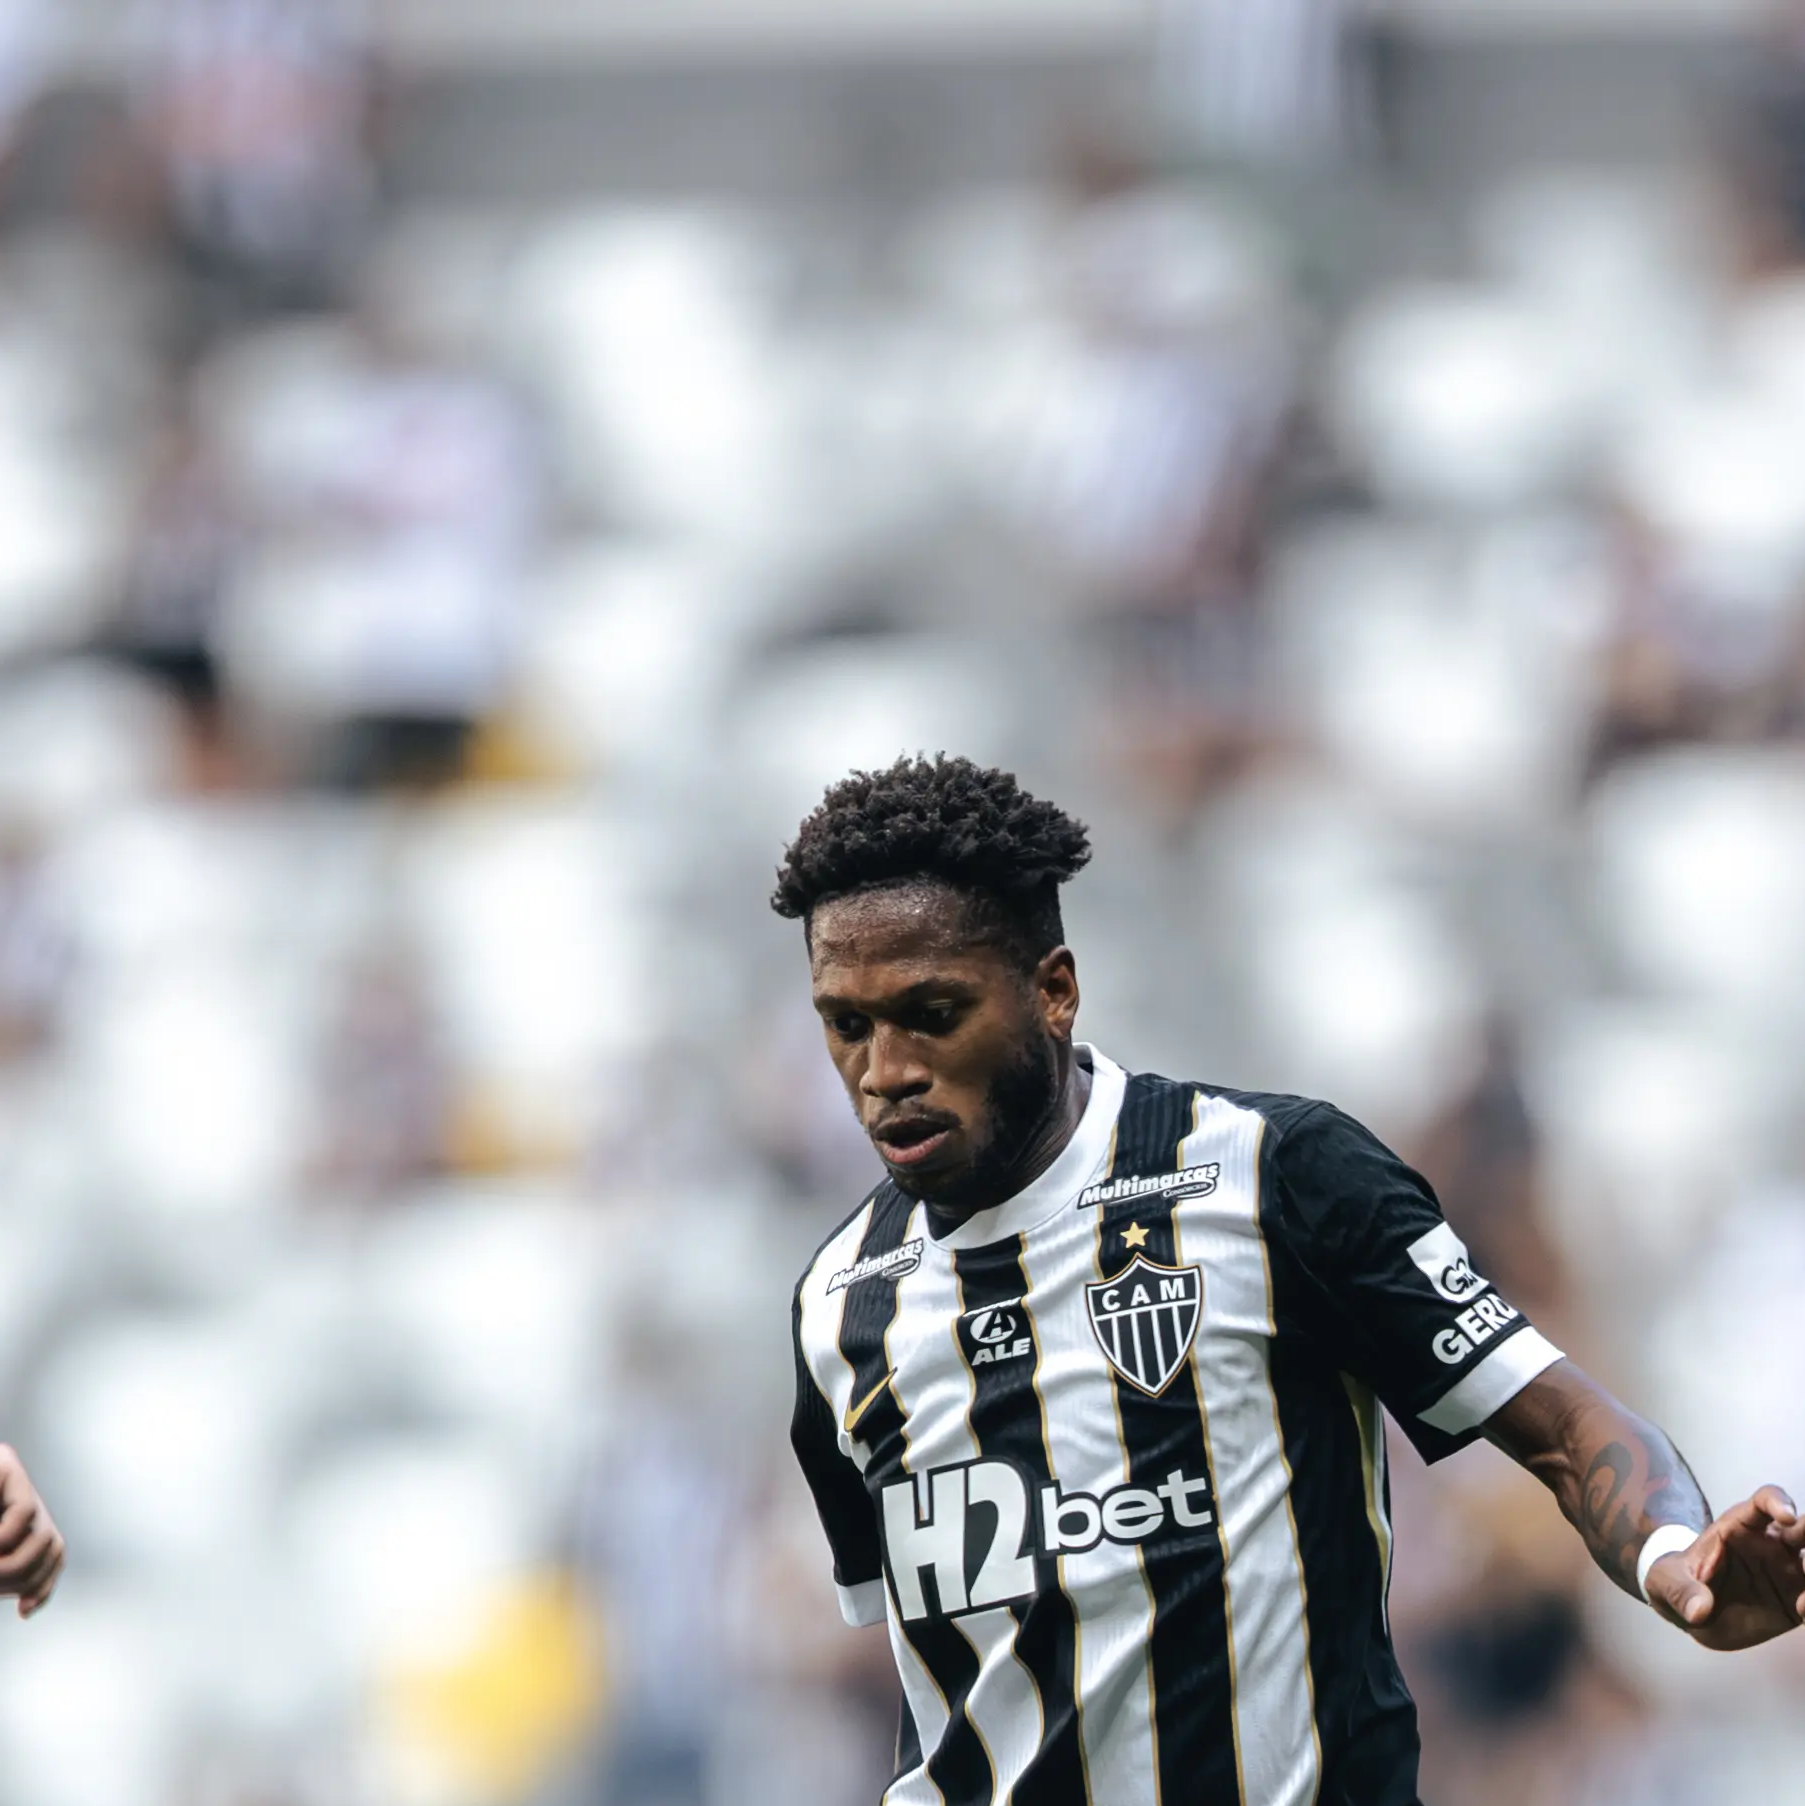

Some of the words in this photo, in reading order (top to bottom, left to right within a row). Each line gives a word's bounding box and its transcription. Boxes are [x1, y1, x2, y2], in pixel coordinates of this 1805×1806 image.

[1079, 1164, 1219, 1208] Multimarcas
[827, 1238, 924, 1293] Multimarcas
[1101, 1277, 1186, 1312] CAM
[972, 1337, 1031, 1366] ALE
